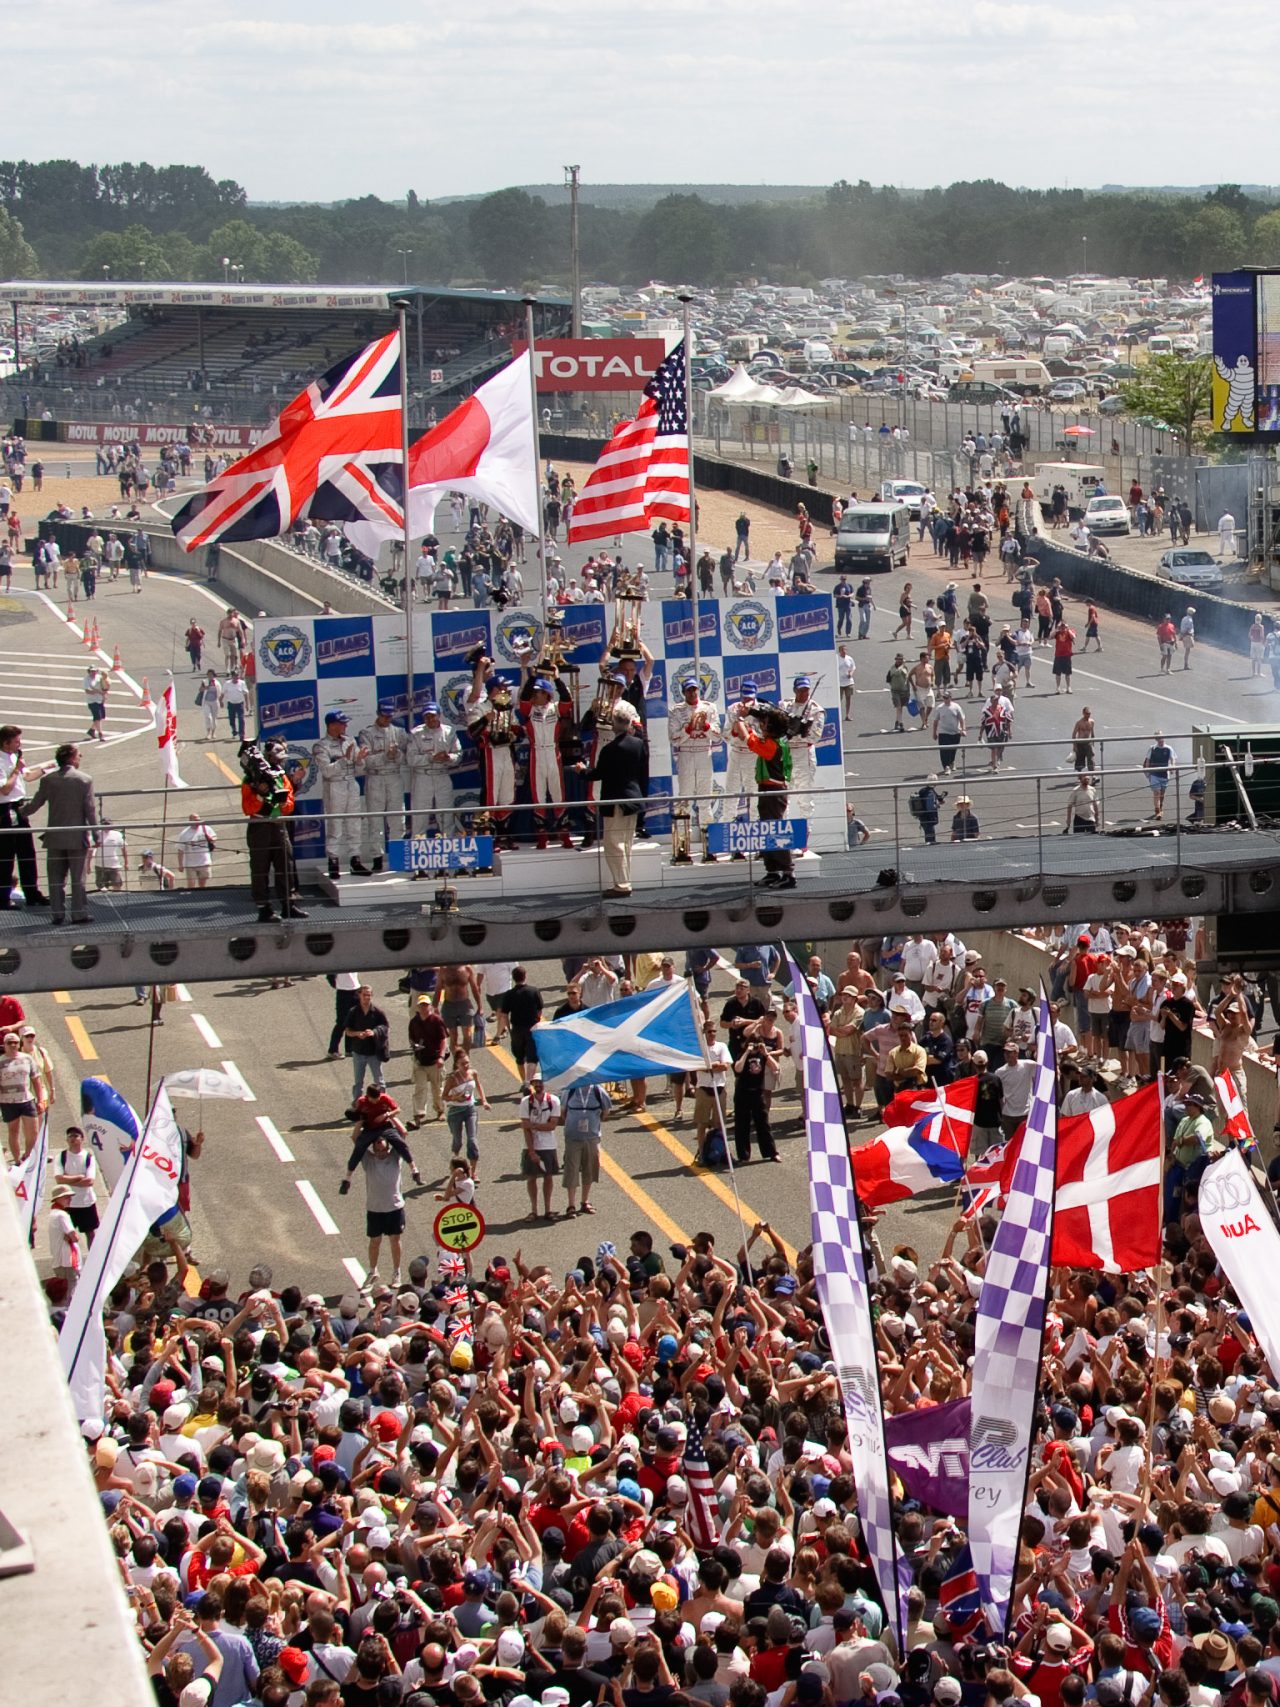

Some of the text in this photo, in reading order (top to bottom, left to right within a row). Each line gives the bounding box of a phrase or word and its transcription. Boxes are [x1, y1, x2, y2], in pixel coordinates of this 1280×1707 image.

[326, 296, 337, 307] 24
[534, 351, 656, 378] TOTAL
[432, 371, 443, 381] 23
[68, 425, 98, 440] MOTUL
[103, 426, 139, 442] MOTUL
[145, 427, 189, 443] MOTUL
[793, 608, 830, 630] MANS
[332, 632, 370, 655] MANS
[277, 695, 315, 718] MANS
[730, 820, 794, 836] PAYS DE LA
[411, 837, 478, 854] PAYS DE LA
[730, 836, 766, 851] LOIRE
[412, 854, 450, 869] LOIRE
[91, 1131, 104, 1151] 4
[441, 1211, 473, 1226] STOP
[971, 1443, 1027, 1469] Club
